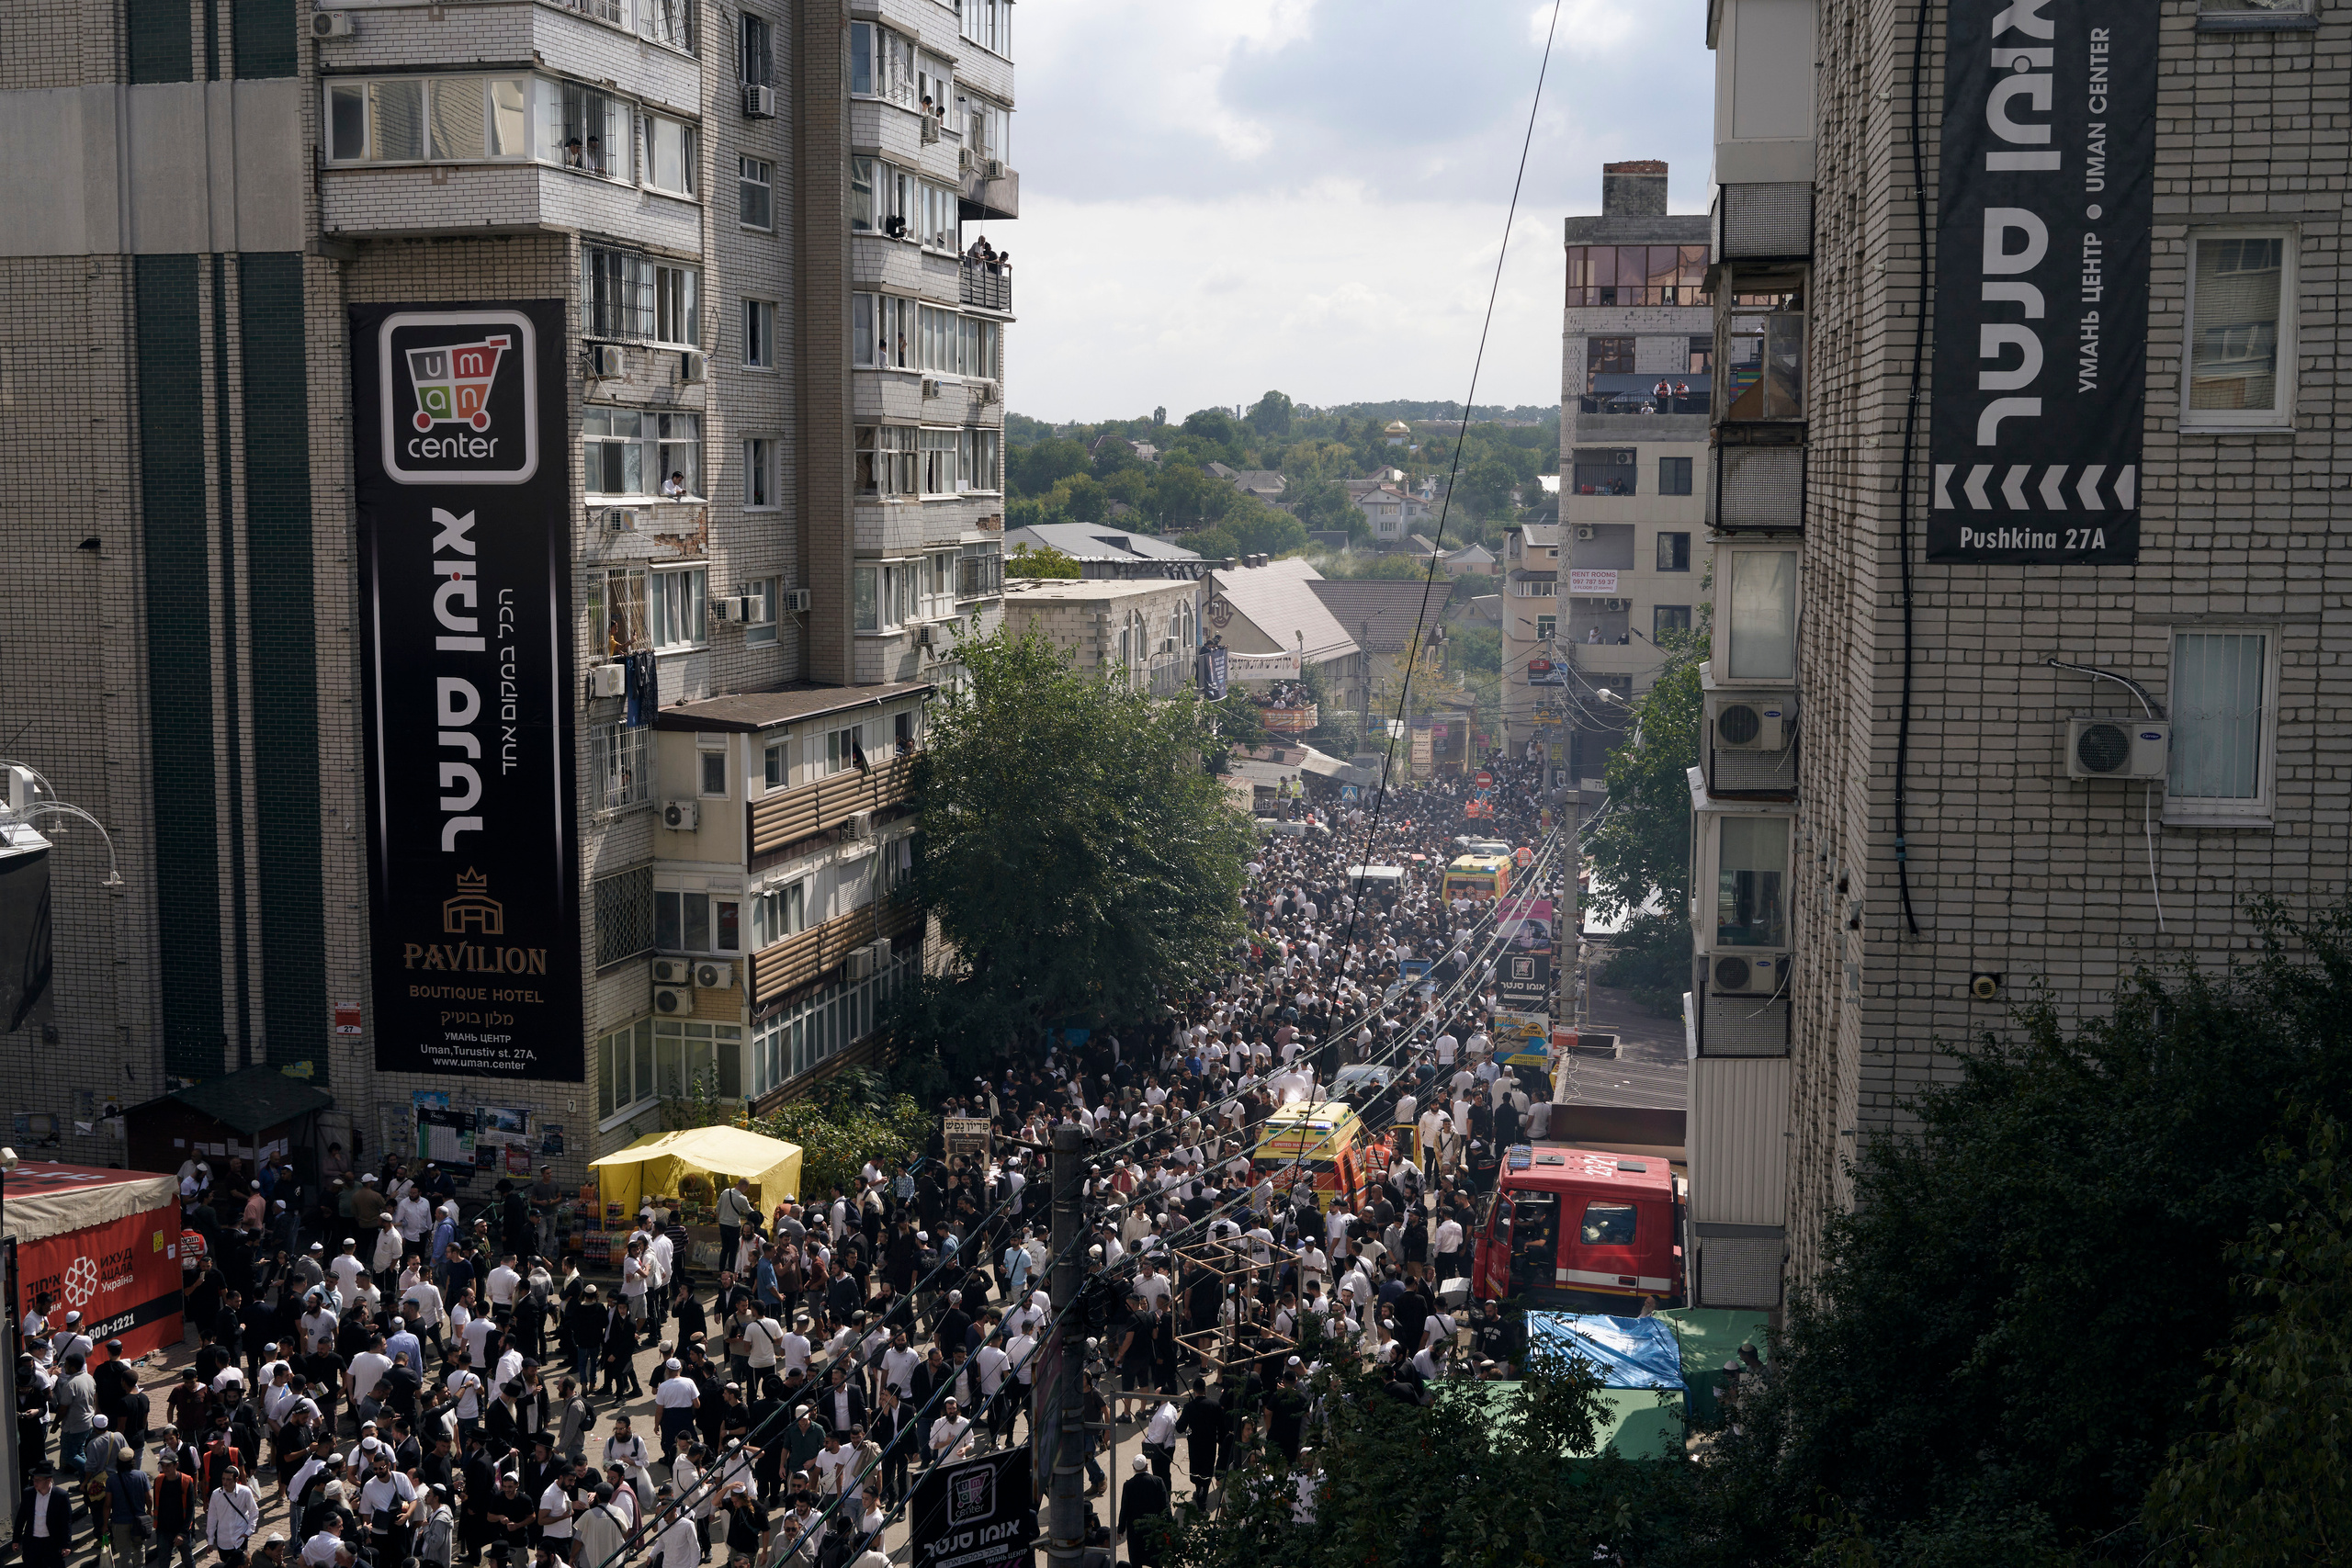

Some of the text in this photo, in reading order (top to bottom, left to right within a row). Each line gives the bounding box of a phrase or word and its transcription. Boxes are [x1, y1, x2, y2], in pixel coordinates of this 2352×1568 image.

[2086, 28, 2109, 191] UMAN CENTER
[2078, 232, 2103, 393] УМАНЬ ЦЕНТР
[1977, 208, 2049, 446] סנטר
[408, 433, 498, 458] center
[1960, 526, 2106, 548] Pushkina 27A
[432, 507, 486, 852] אומן סנטר
[497, 588, 518, 775] הכל במקום אחד
[402, 940, 547, 976] PAVILION
[410, 985, 544, 1003] BOUTIQUE HOTEL
[1500, 981, 1524, 989] סנטר
[441, 1010, 514, 1028] מלון בוטיק
[445, 1032, 511, 1044] УМАНЬ ЦЕНТР
[433, 1056, 526, 1070] www.uman.center
[498, 1048, 511, 1058] st.
[100, 1247, 132, 1268] ИХУД
[100, 1261, 133, 1281] АЦАЛА
[27, 1272, 61, 1295] איחוד
[101, 1274, 134, 1293] Україна
[955, 1504, 985, 1517] center
[923, 1519, 1020, 1557] אומן סנטר
[960, 1552, 984, 1562] במקום
[985, 1547, 1001, 1556] הכל
[985, 1549, 1028, 1565] УМАНЬ ЦЕНТР
